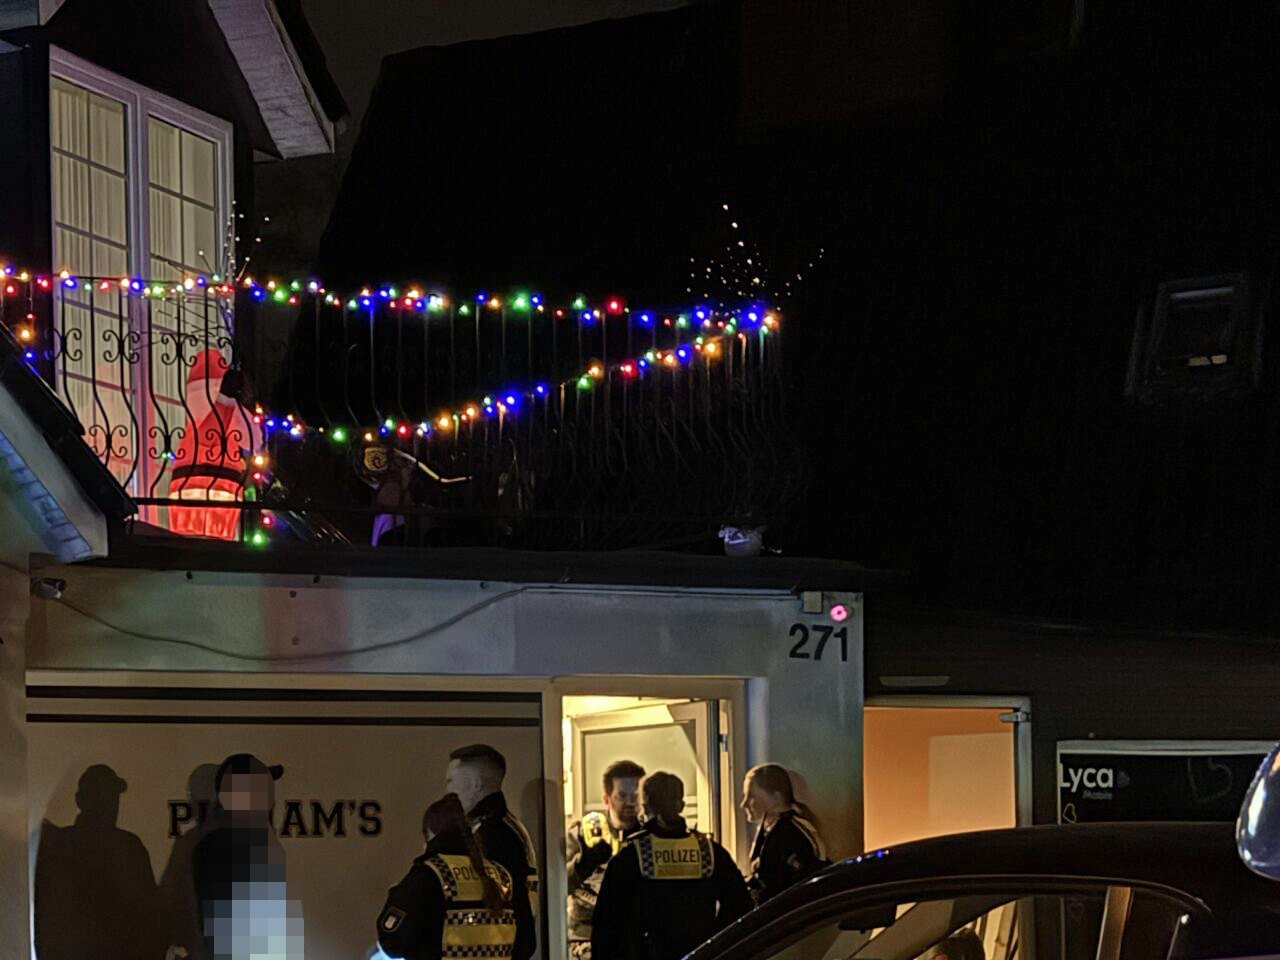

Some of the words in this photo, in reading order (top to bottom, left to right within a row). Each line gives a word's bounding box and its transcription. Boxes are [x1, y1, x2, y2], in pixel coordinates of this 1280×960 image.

[788, 622, 848, 662] 271
[1059, 762, 1114, 793] Lyca
[167, 799, 382, 839] PIAM'S
[653, 848, 702, 865] POLIZEI
[452, 865, 500, 881] POLEI
